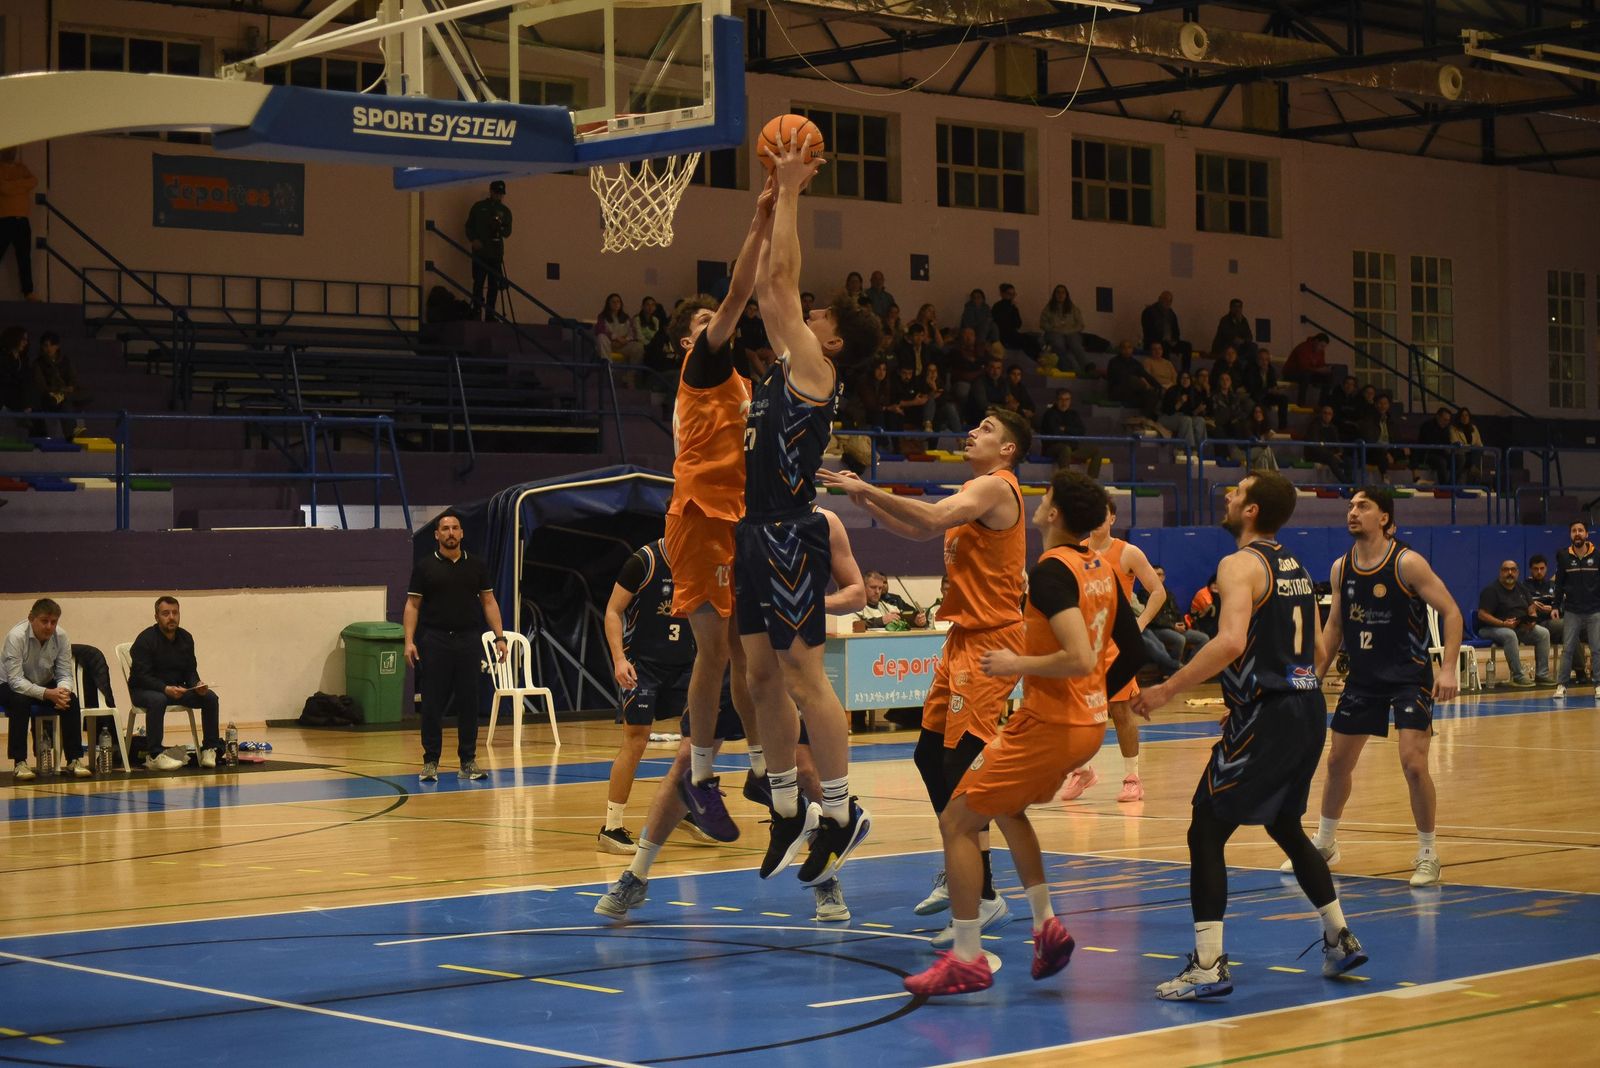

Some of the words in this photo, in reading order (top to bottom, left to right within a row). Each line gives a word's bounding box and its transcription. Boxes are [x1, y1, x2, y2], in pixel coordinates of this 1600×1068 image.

[352, 105, 428, 132] SPORT
[429, 113, 518, 141] SYSTEM
[668, 624, 681, 642] 3
[1292, 604, 1304, 656] 1
[1359, 630, 1374, 650] 12
[872, 652, 945, 683] deport
